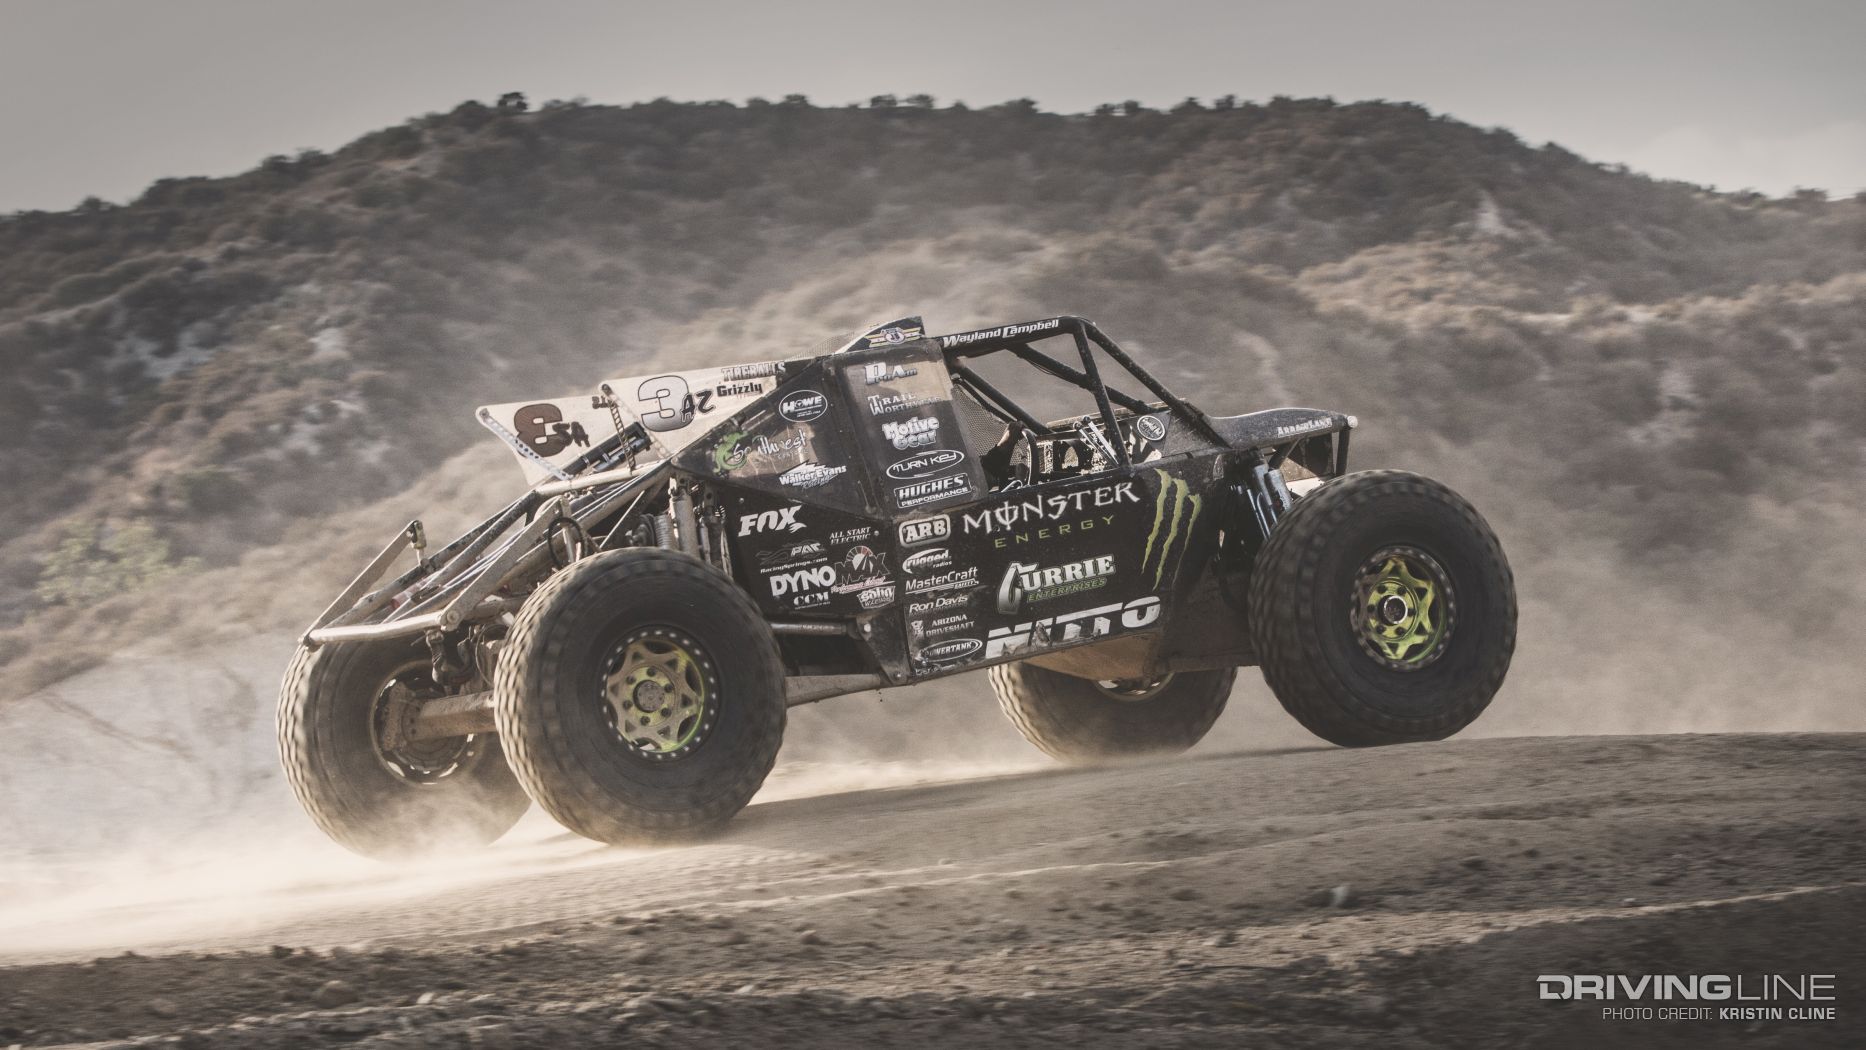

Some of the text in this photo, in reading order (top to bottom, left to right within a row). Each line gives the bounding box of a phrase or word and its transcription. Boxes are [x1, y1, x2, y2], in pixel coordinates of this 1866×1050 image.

[943, 319, 1059, 348] Wayland Campbell
[716, 382, 763, 398] Grizzly
[637, 375, 694, 432] 3
[680, 389, 716, 422] AZ
[782, 396, 822, 414] HOWE
[882, 416, 939, 440] Motive
[893, 430, 937, 450] Gear
[779, 466, 847, 485] Walker Evans
[893, 459, 927, 474] TURN
[898, 475, 965, 500] HUGHES
[901, 487, 968, 507] PERFORMANCE
[962, 481, 1140, 534] MONSTER
[737, 505, 806, 537] FOX
[903, 520, 946, 543] ARB
[994, 515, 1114, 549] ENERGY
[830, 527, 871, 540] ALL START
[905, 566, 978, 591] MasterCraft
[997, 554, 1116, 615] CURRIE
[793, 591, 829, 606] CCM
[1027, 578, 1108, 603] ENTERPRISES
[909, 594, 969, 613] Ron Davis
[926, 621, 975, 638] DRIVESHAFT
[931, 614, 967, 627] ARIZONA
[985, 596, 1161, 659] NITTO
